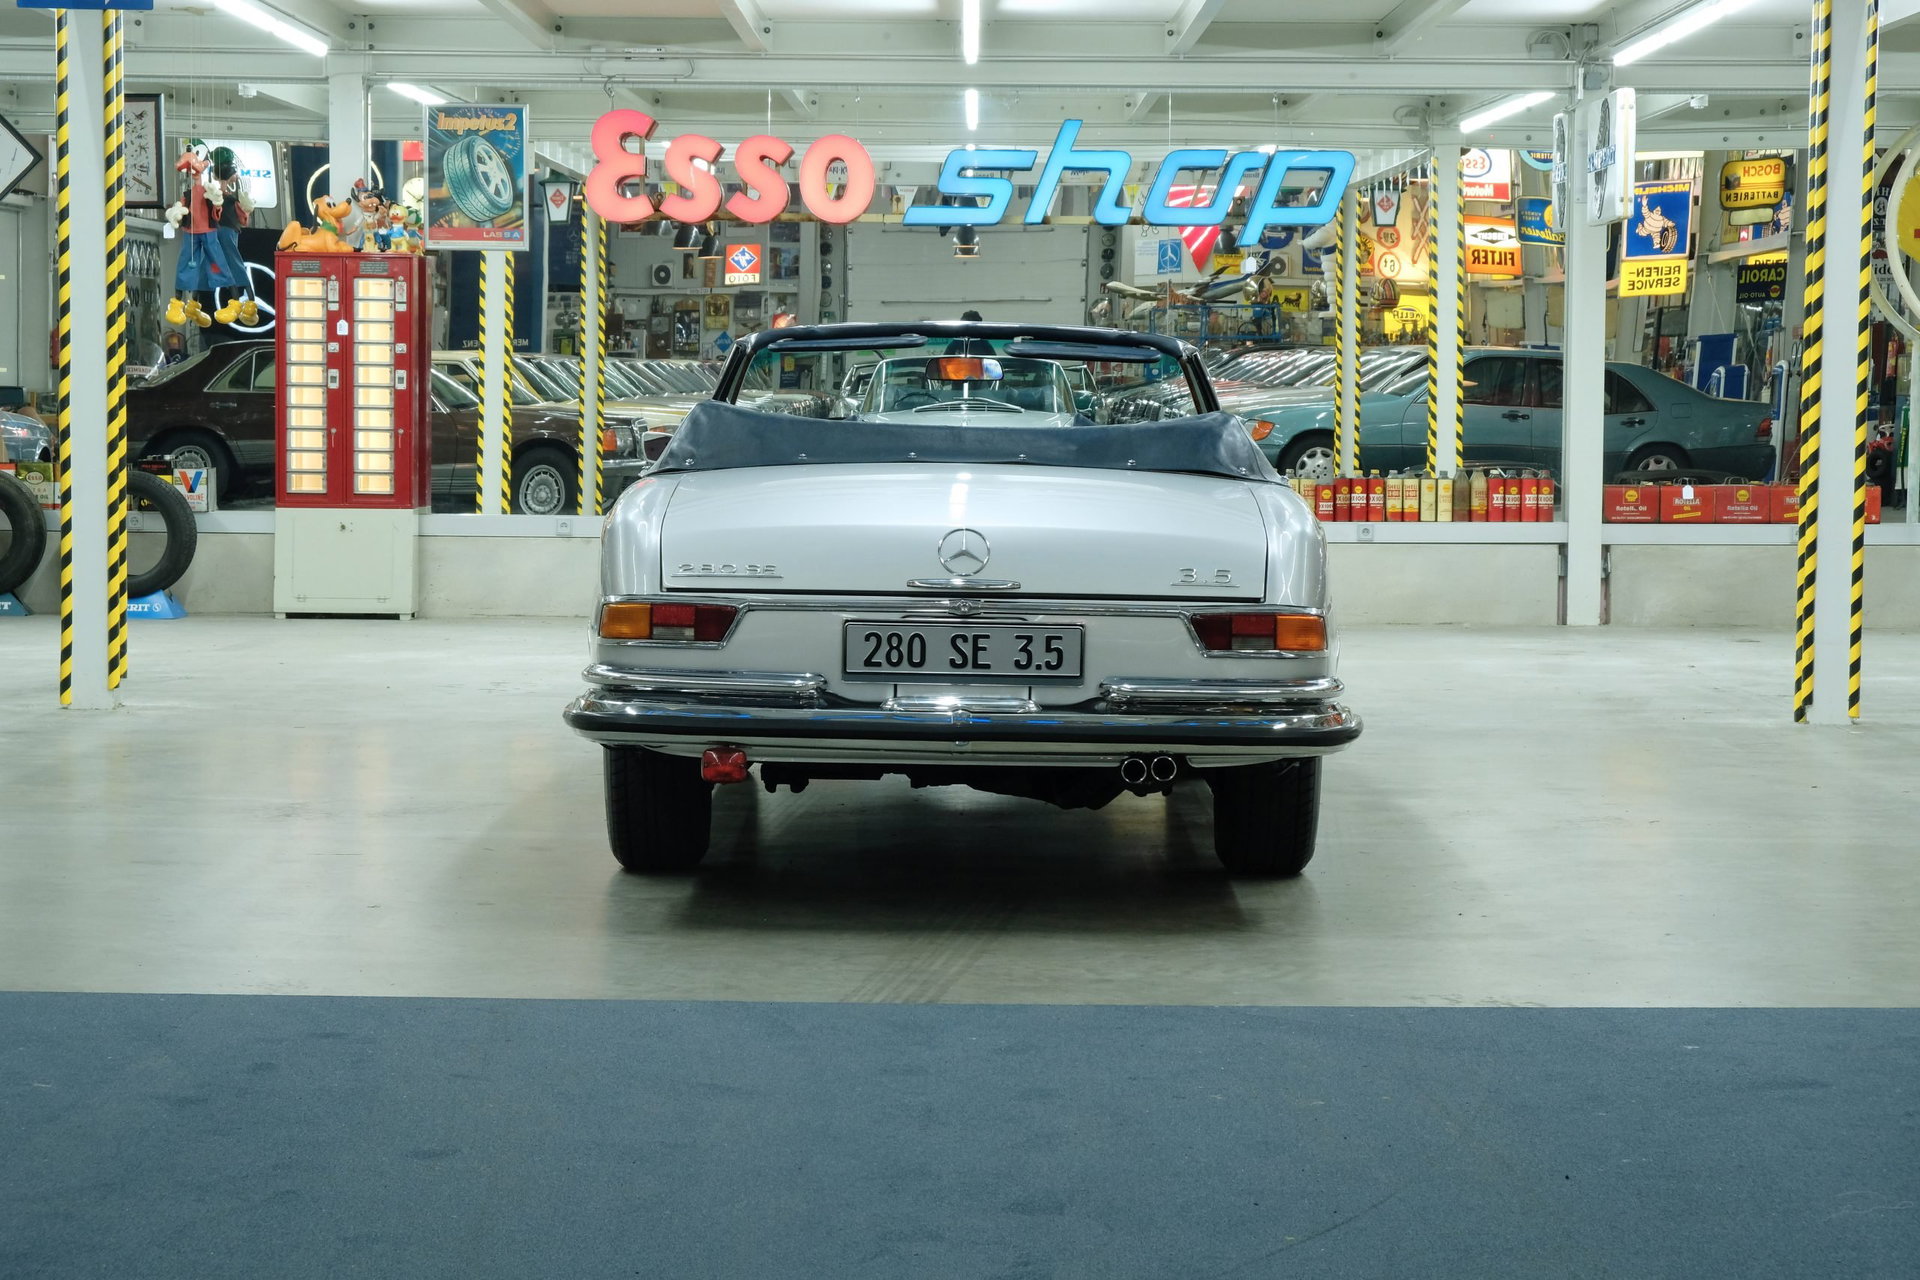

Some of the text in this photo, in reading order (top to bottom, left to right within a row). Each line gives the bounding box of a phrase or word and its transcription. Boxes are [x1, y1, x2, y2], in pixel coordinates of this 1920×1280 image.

[903, 118, 1356, 247] shop
[483, 230, 521, 240] LASSA
[184, 493, 205, 501] VOLINE
[1179, 568, 1232, 584] 3.5
[863, 631, 1065, 671] 280 SE 3.5
